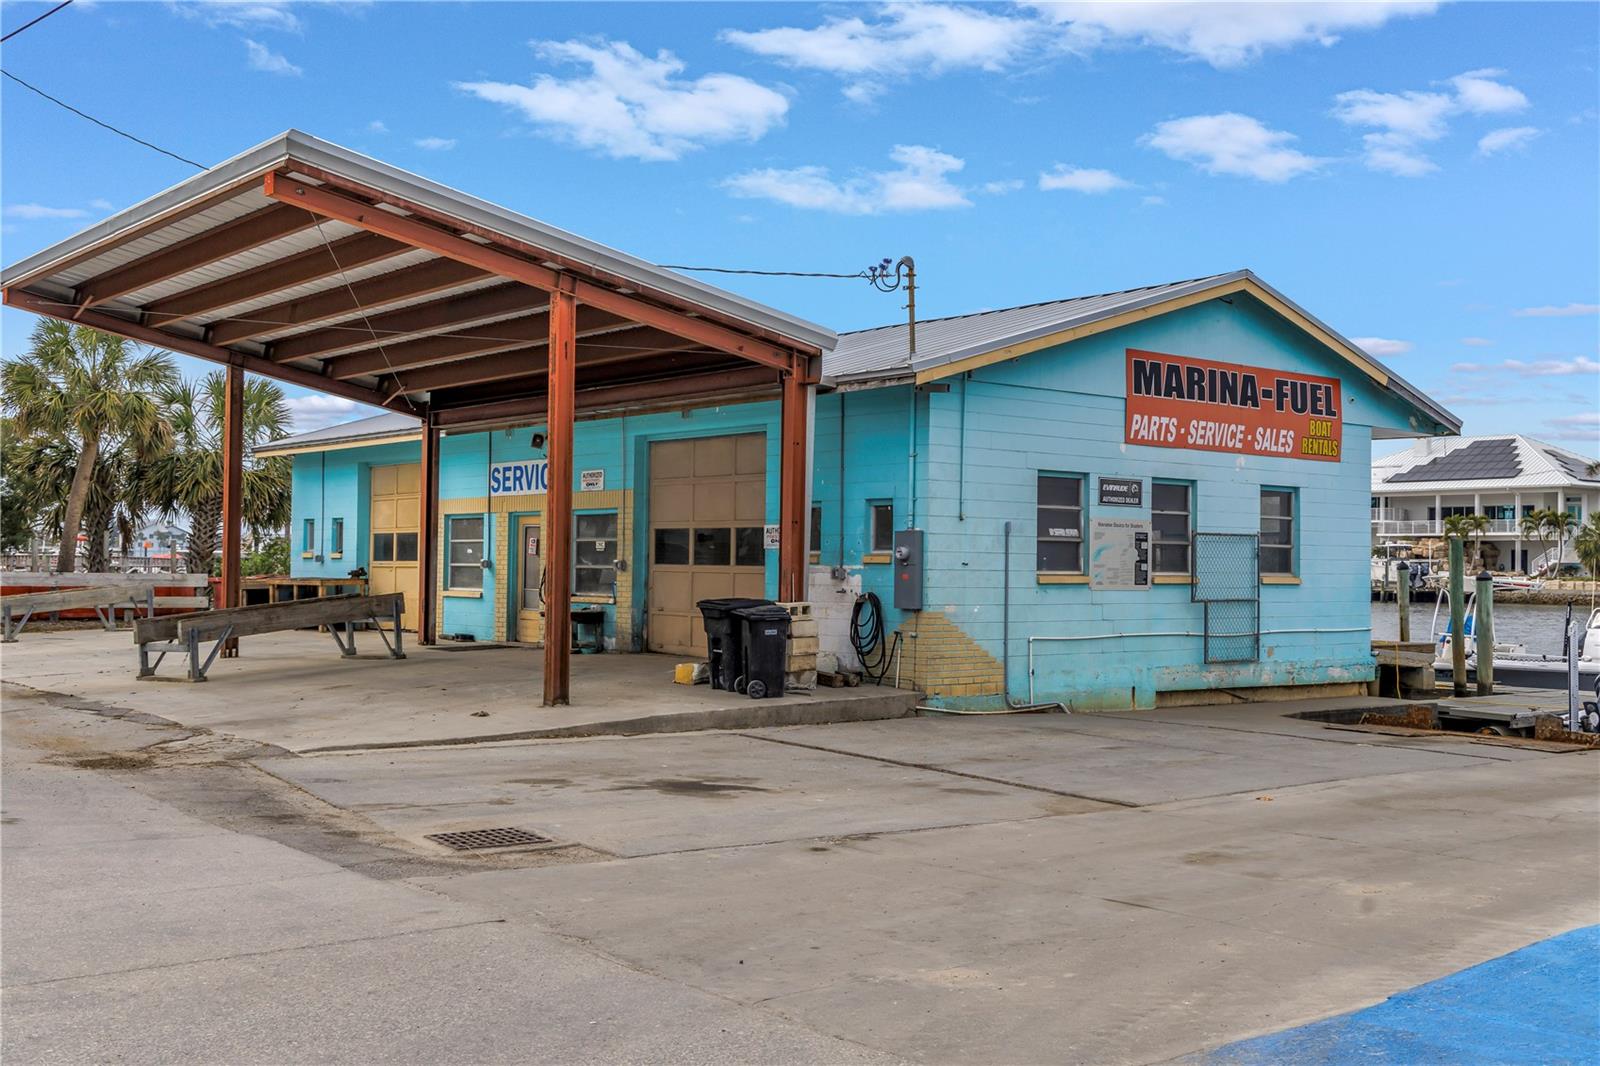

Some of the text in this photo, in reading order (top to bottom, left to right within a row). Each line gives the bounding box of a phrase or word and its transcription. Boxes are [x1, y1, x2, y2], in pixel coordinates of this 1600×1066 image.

[1132, 358, 1337, 418] MARINA-FUEL
[1130, 414, 1294, 453] PARTS SERVICE SALES
[1309, 418, 1332, 437] BOAT
[1301, 437, 1338, 457] RENTALS
[491, 463, 548, 493] SERVIC
[1102, 483, 1129, 492] EVINRUDE
